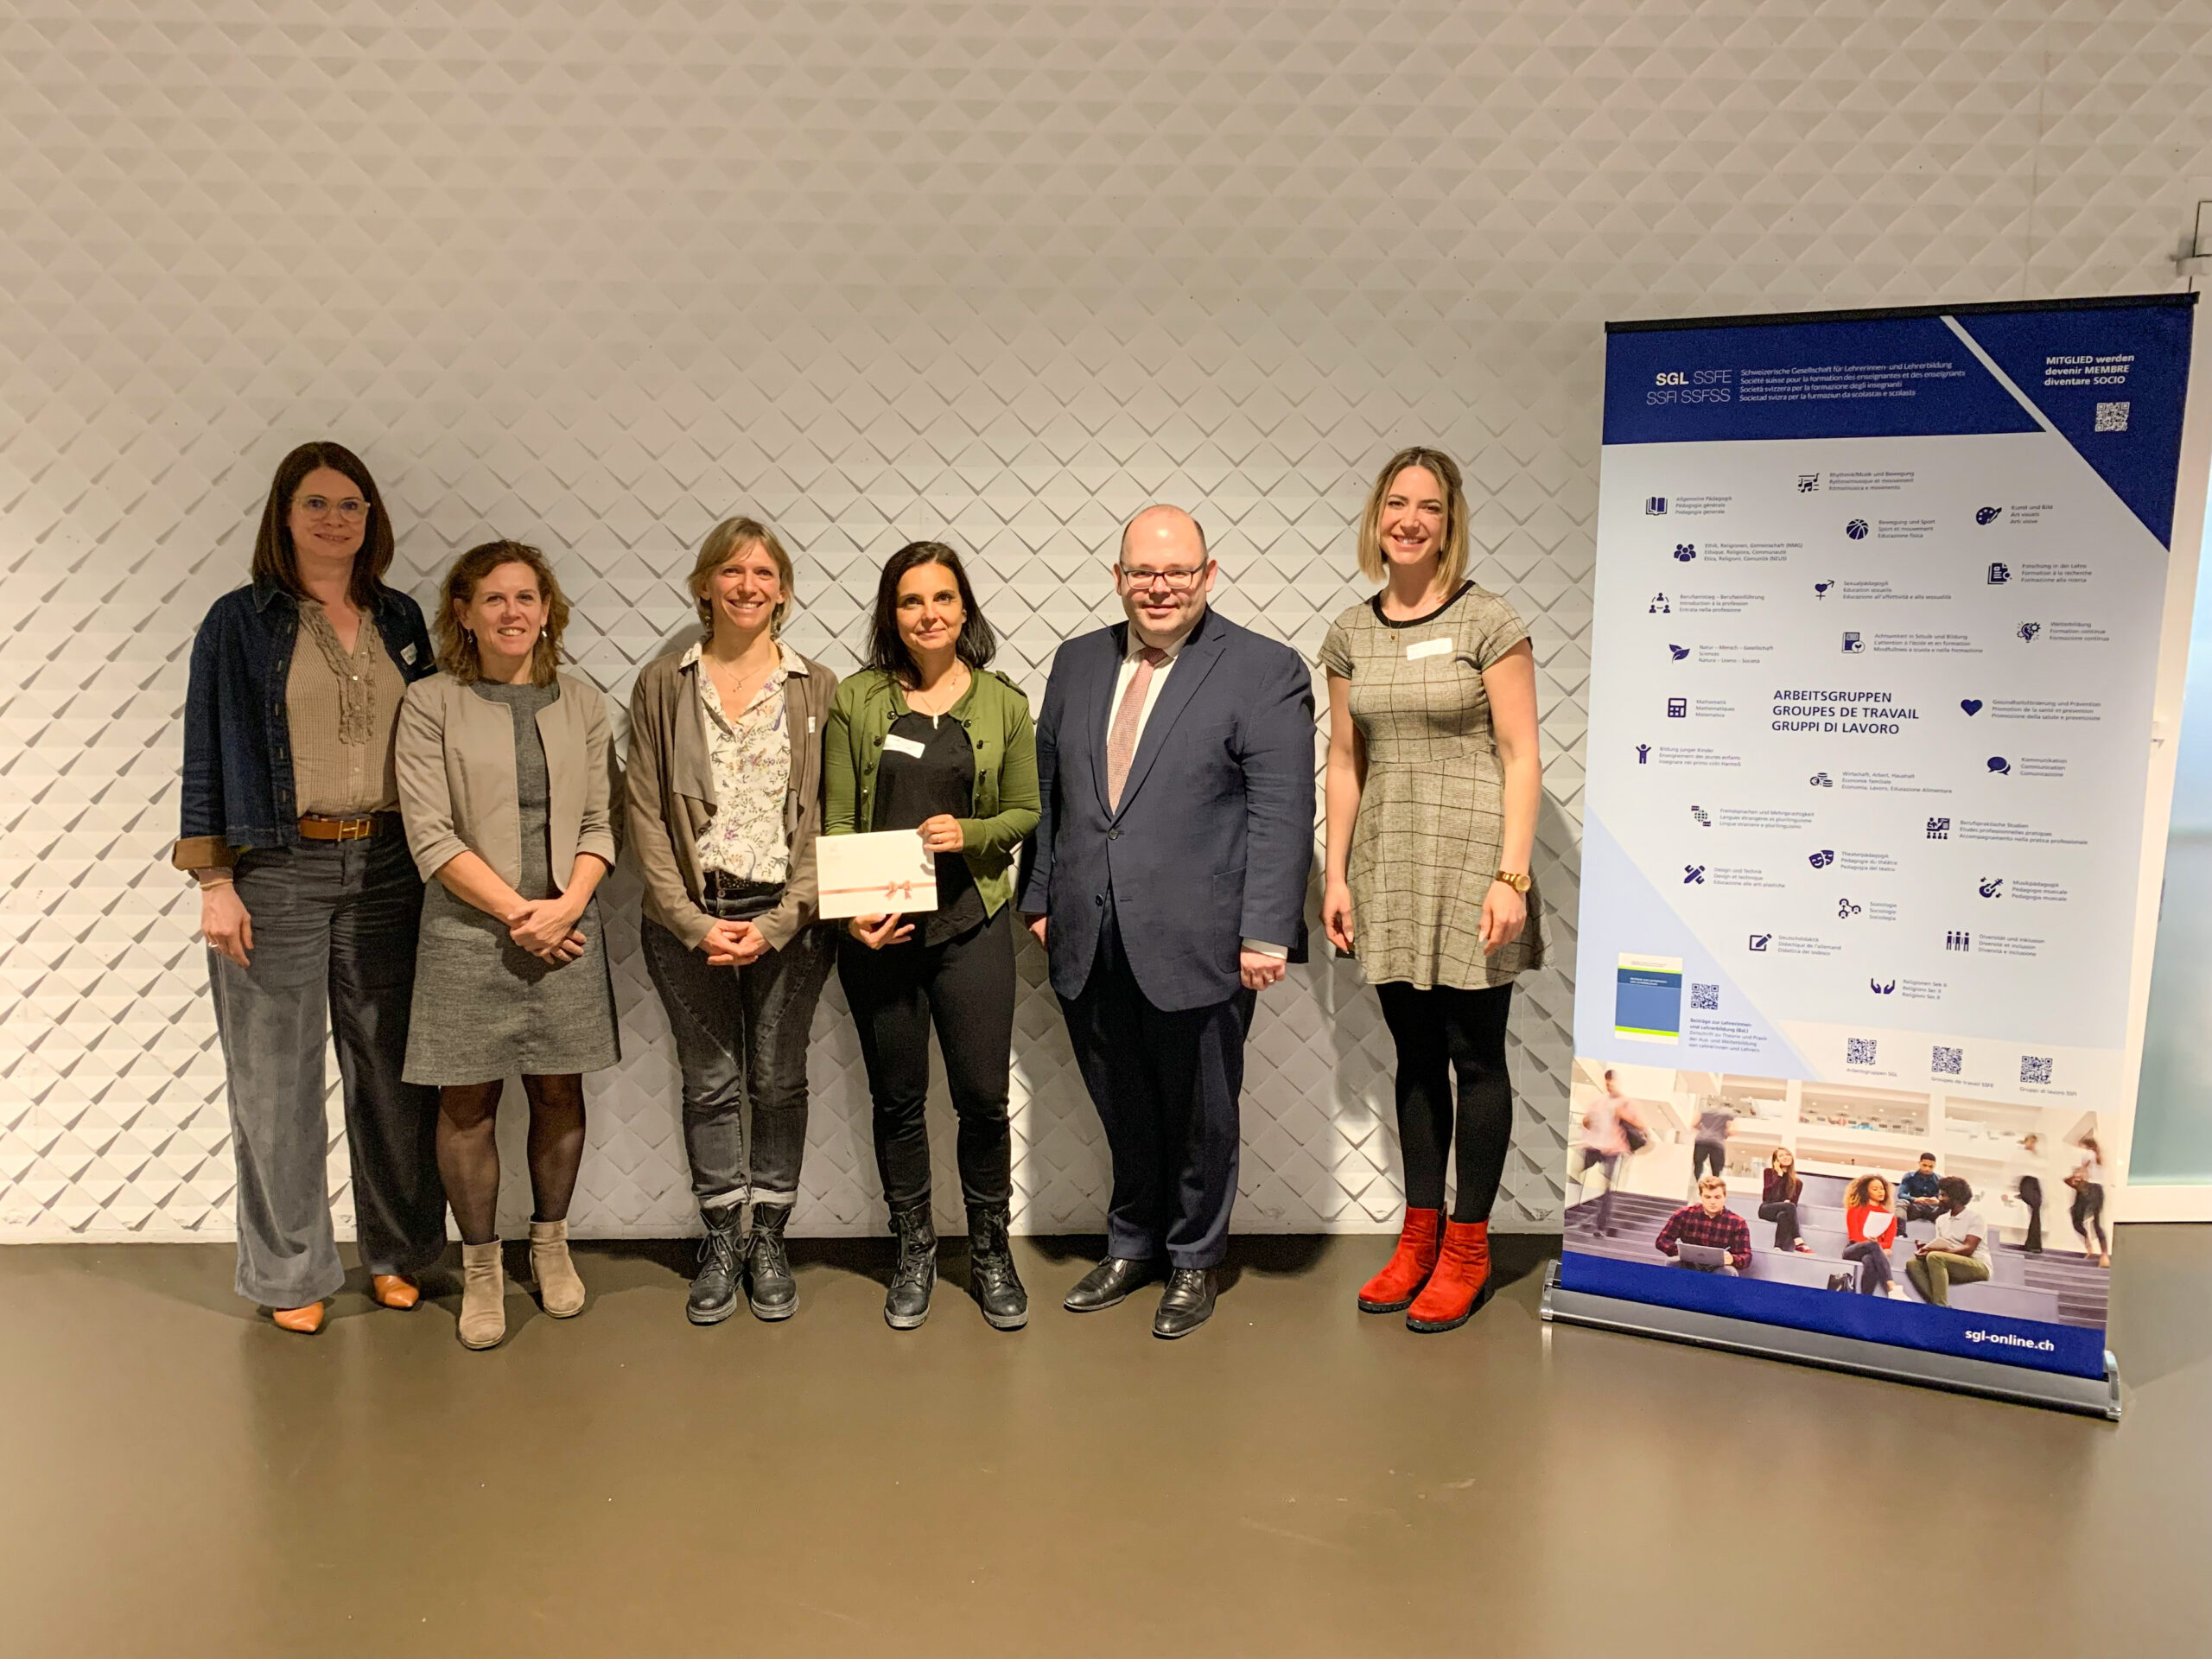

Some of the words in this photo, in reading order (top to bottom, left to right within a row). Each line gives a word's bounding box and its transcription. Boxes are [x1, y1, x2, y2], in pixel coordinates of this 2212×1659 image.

[2047, 356, 2093, 364] MITGLIED
[2096, 354, 2134, 363] werden
[1741, 367, 1790, 376] Schweizerische
[1792, 366, 1832, 374] Gesellschaft
[1904, 361, 1952, 371] Lehrerbildung
[2045, 367, 2082, 375] devenir
[2085, 365, 2129, 374] MEMBRE
[1656, 372, 1688, 386] SGL
[1694, 370, 1732, 384] SSFE
[2044, 377, 2090, 385] diventare
[2094, 376, 2125, 384] SOCIO
[1681, 389, 1730, 403] SSFSS
[1774, 690, 1892, 702] ARBEITSGRUPPEN
[1773, 706, 1835, 716] GROUPES
[1840, 707, 1857, 717] DE
[1863, 708, 1919, 719] TRAVAIL
[1772, 721, 1819, 732] GRUPPI
[1824, 723, 1837, 732] DI
[1843, 723, 1899, 734] LAVORO
[1965, 1330, 2054, 1351] sgl-online.ch
